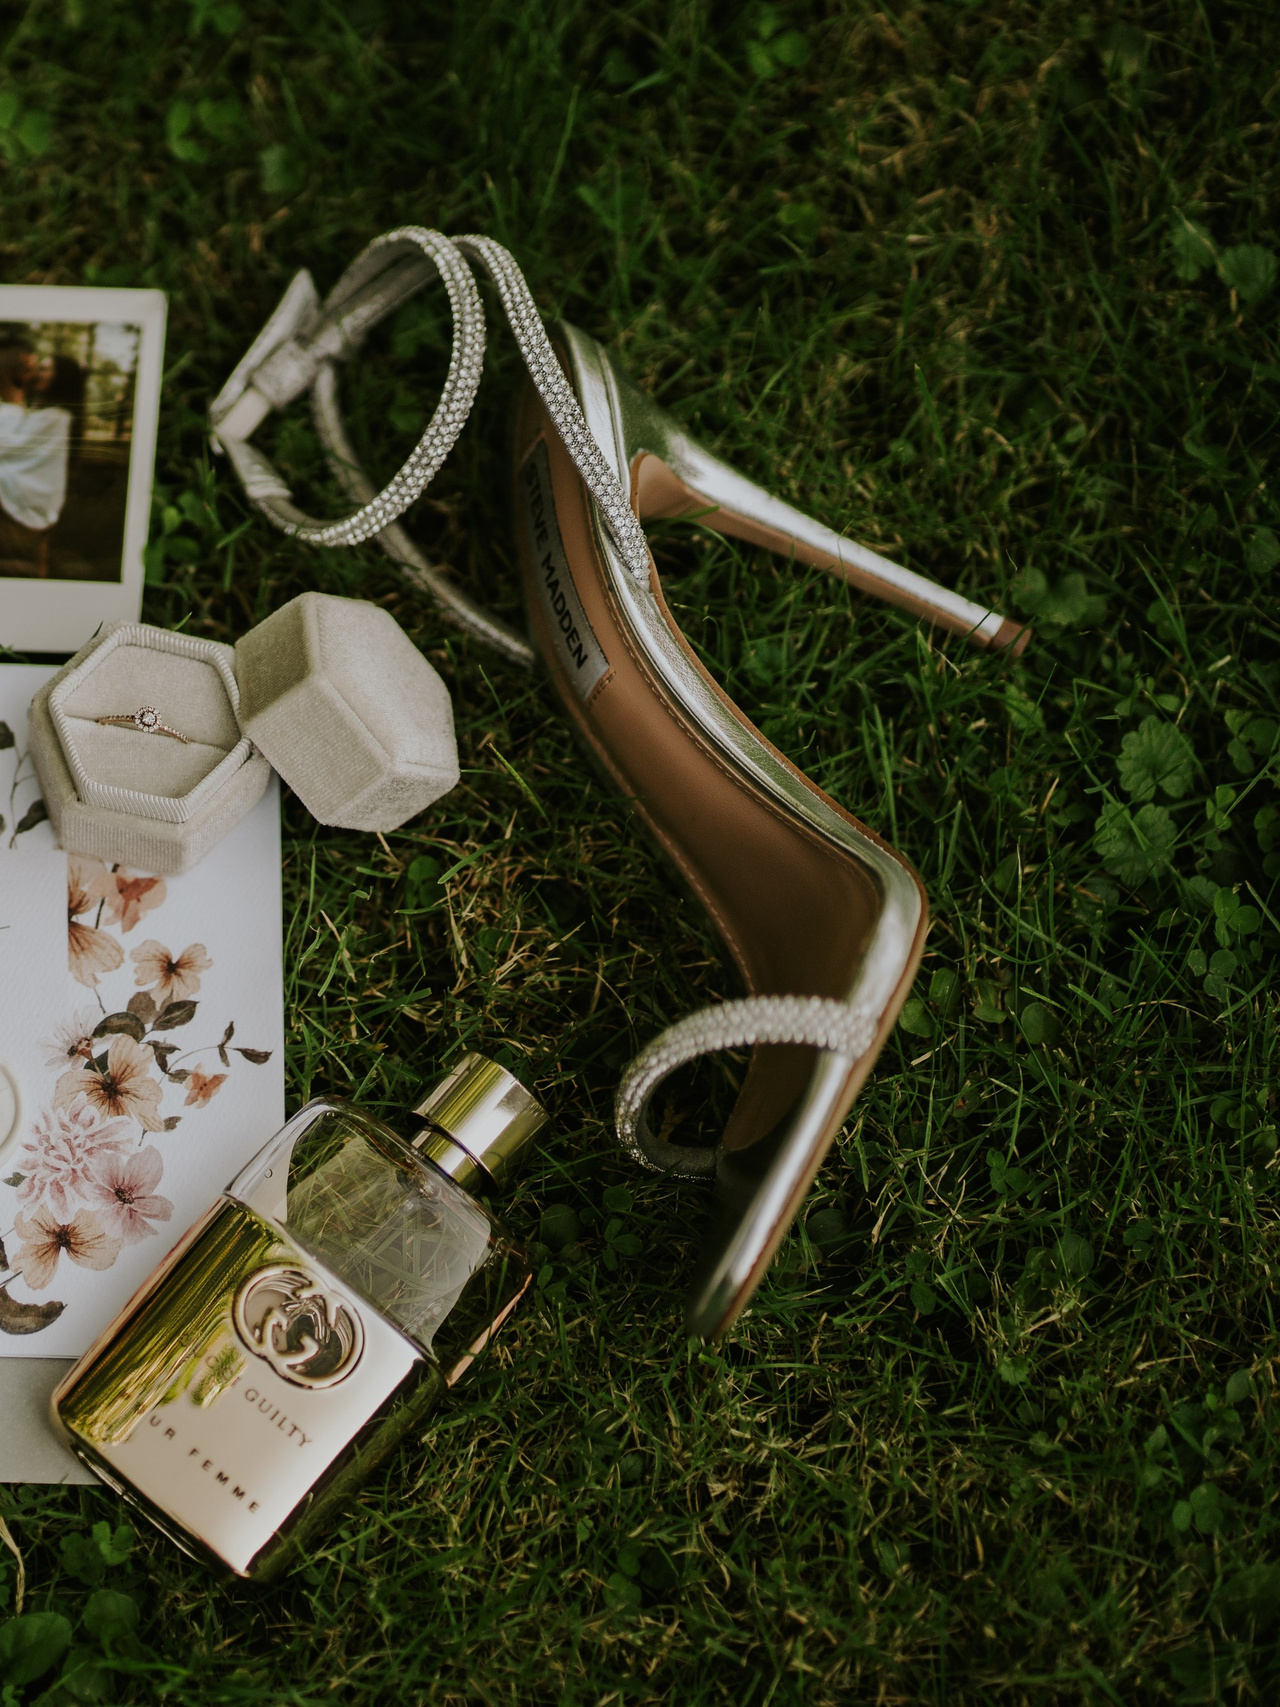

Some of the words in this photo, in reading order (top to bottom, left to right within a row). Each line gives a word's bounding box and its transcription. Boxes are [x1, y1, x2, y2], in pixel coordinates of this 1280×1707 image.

[541, 551, 589, 670] MADDEN
[245, 1388, 312, 1448] GUILTY
[188, 1447, 261, 1514] FEMME
